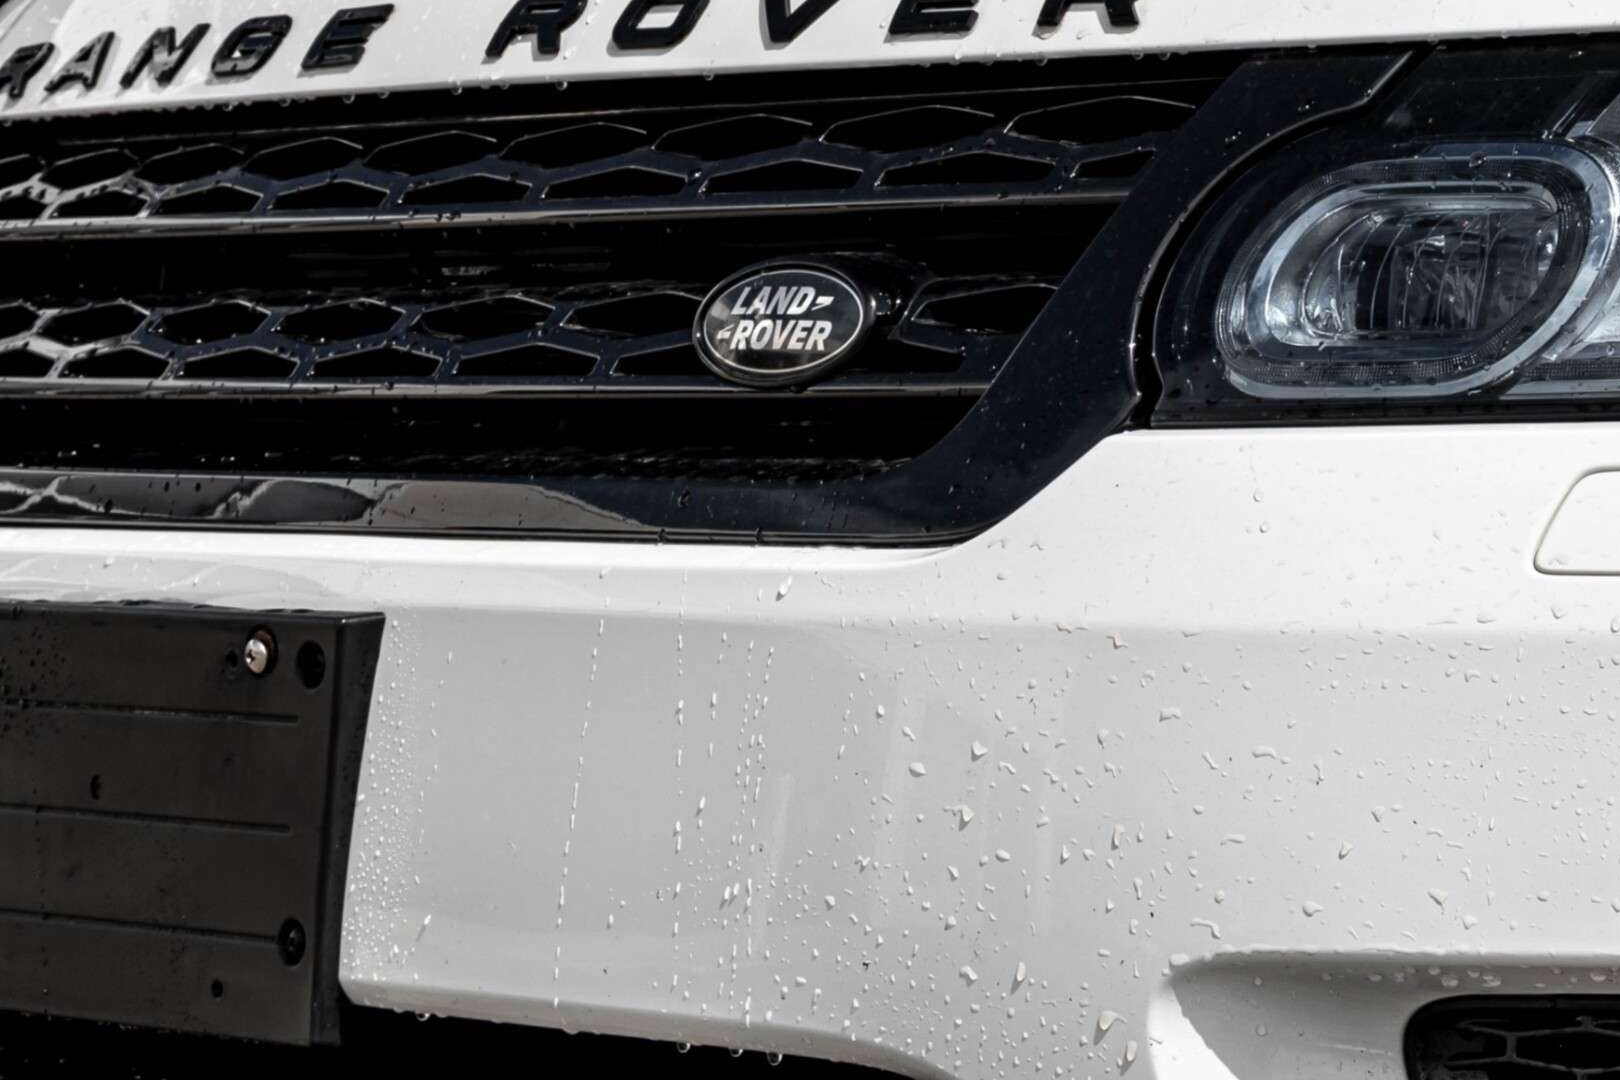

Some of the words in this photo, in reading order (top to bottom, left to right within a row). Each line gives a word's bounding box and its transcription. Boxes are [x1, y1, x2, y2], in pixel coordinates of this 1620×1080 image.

[0, 4, 394, 101] RANGE
[730, 286, 817, 315] LAND
[729, 319, 833, 351] ROVER
